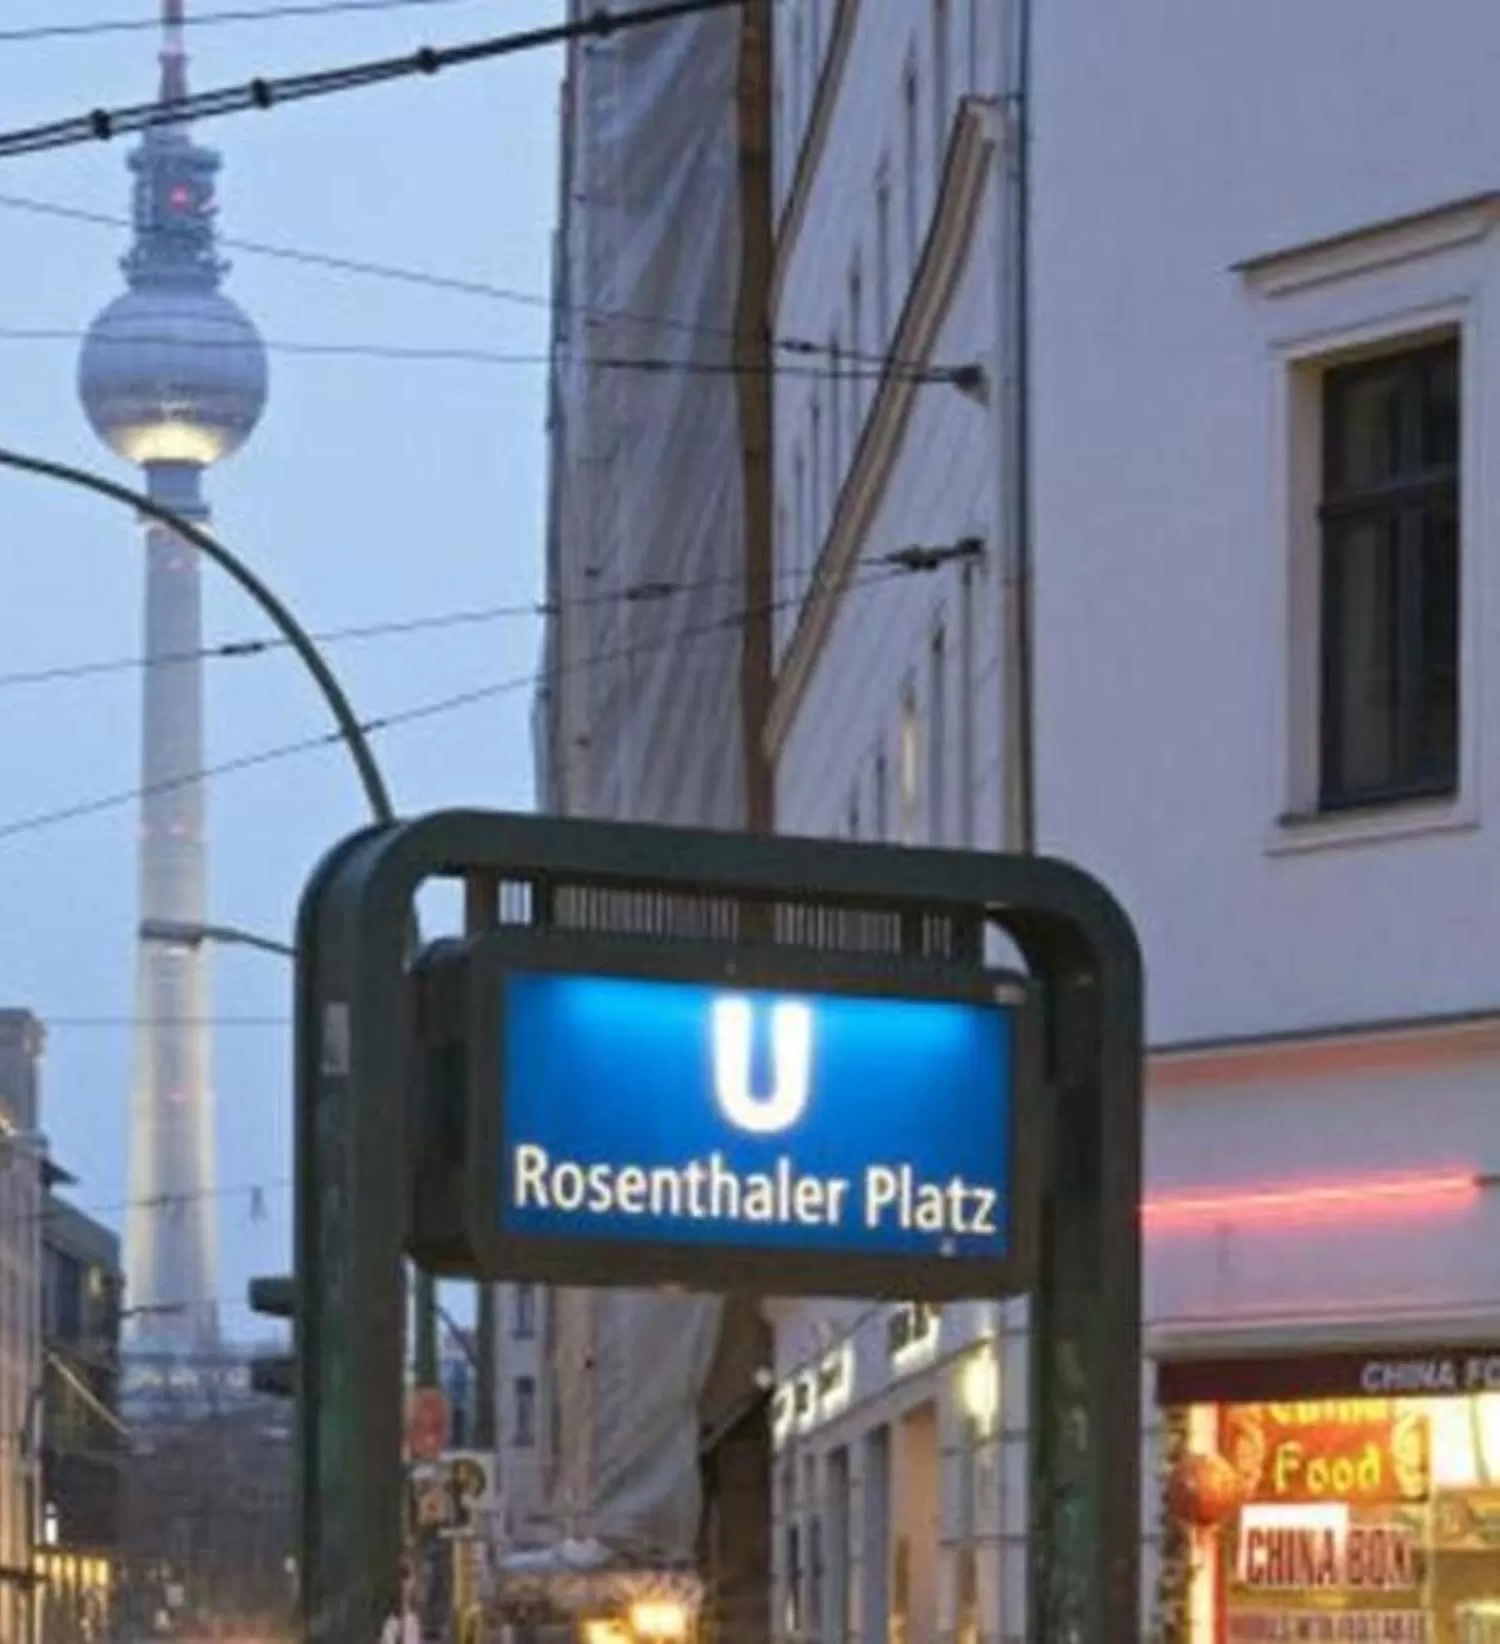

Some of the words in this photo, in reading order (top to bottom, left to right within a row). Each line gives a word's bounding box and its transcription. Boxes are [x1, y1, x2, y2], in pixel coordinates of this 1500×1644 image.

[712, 995, 813, 1133] U
[514, 1143, 848, 1226] Rosenthaler
[865, 1163, 997, 1235] Platz
[1361, 1359, 1454, 1390] CHINA
[1276, 1438, 1380, 1493] Food
[1247, 1526, 1337, 1585] CHINA
